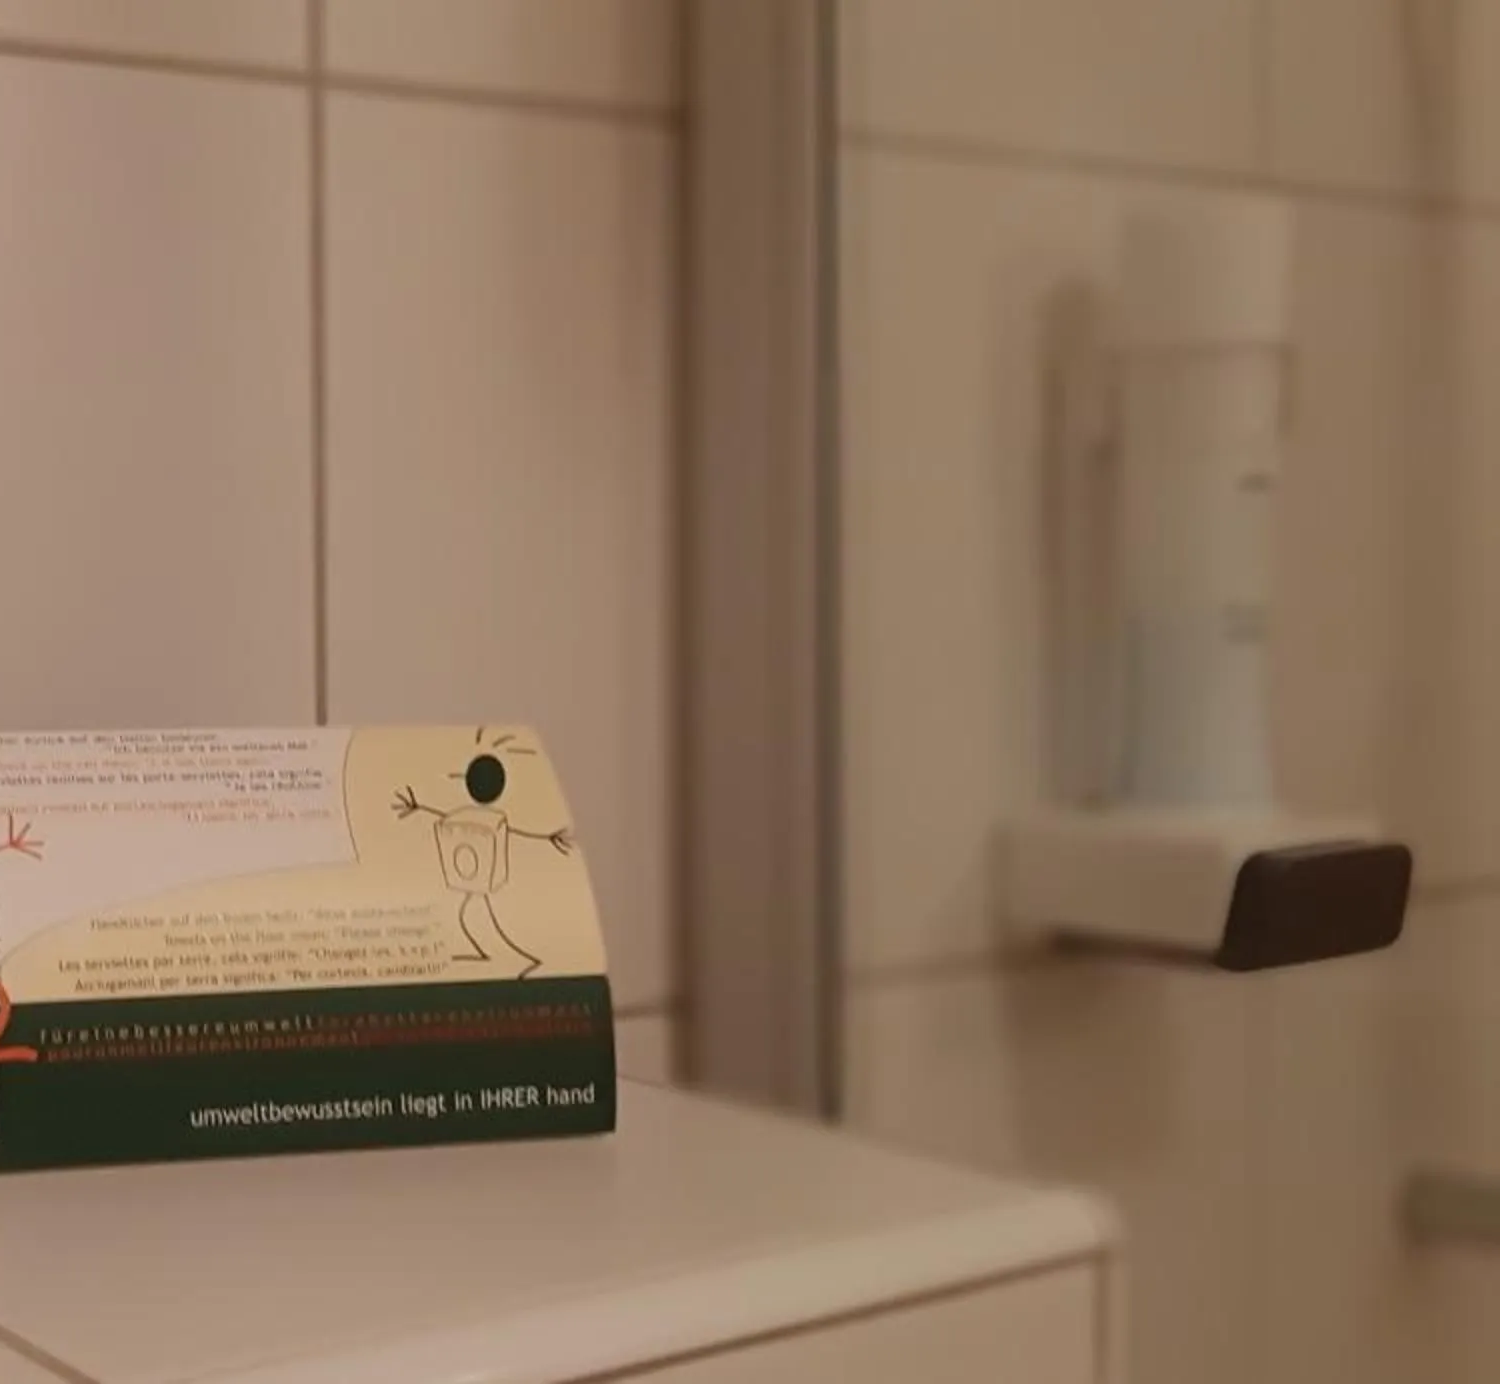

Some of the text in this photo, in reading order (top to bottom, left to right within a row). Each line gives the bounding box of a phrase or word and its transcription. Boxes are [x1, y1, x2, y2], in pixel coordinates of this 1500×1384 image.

[190, 1081, 595, 1128] umweltbewusstsein liegt in IHRER hand
